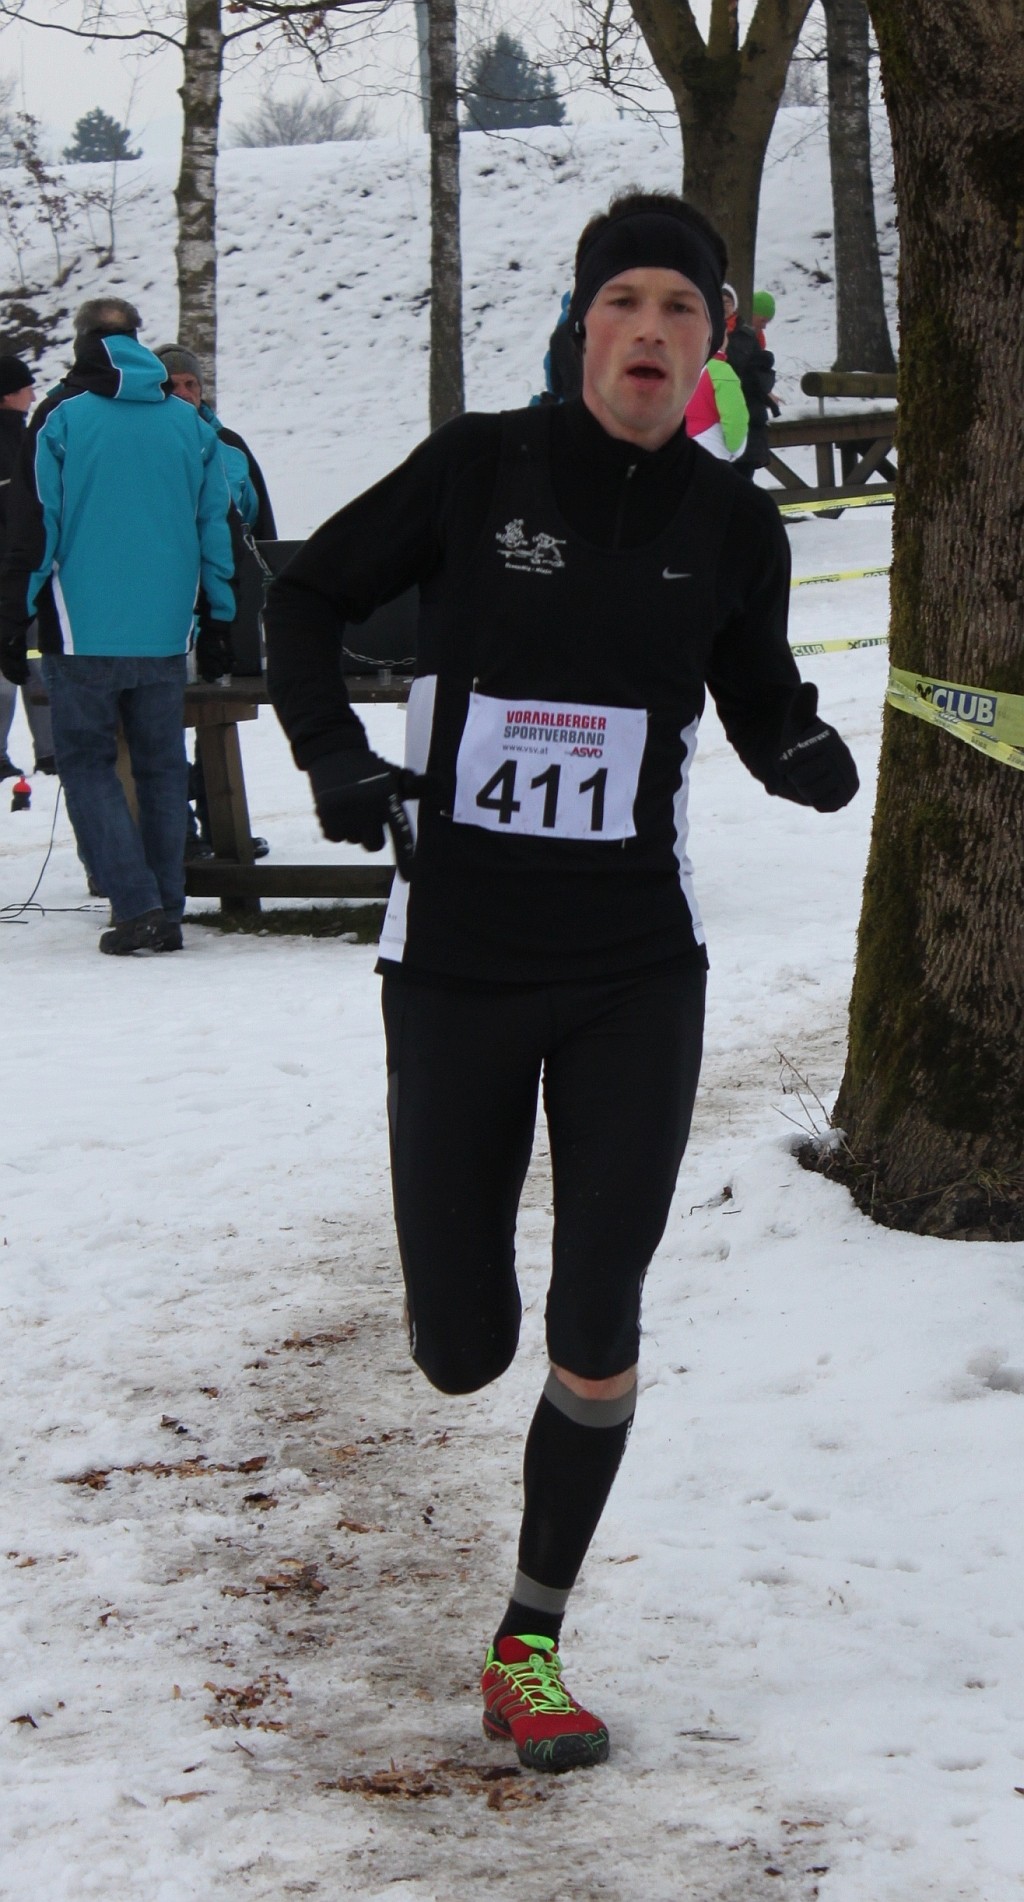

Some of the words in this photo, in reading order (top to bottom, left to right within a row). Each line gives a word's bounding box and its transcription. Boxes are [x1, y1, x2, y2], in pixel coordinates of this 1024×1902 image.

[506, 710, 607, 731] VORARLBERGER
[503, 725, 605, 746] SPORTVERBAND
[502, 744, 548, 755] www.vsv.at
[476, 760, 608, 832] 411
